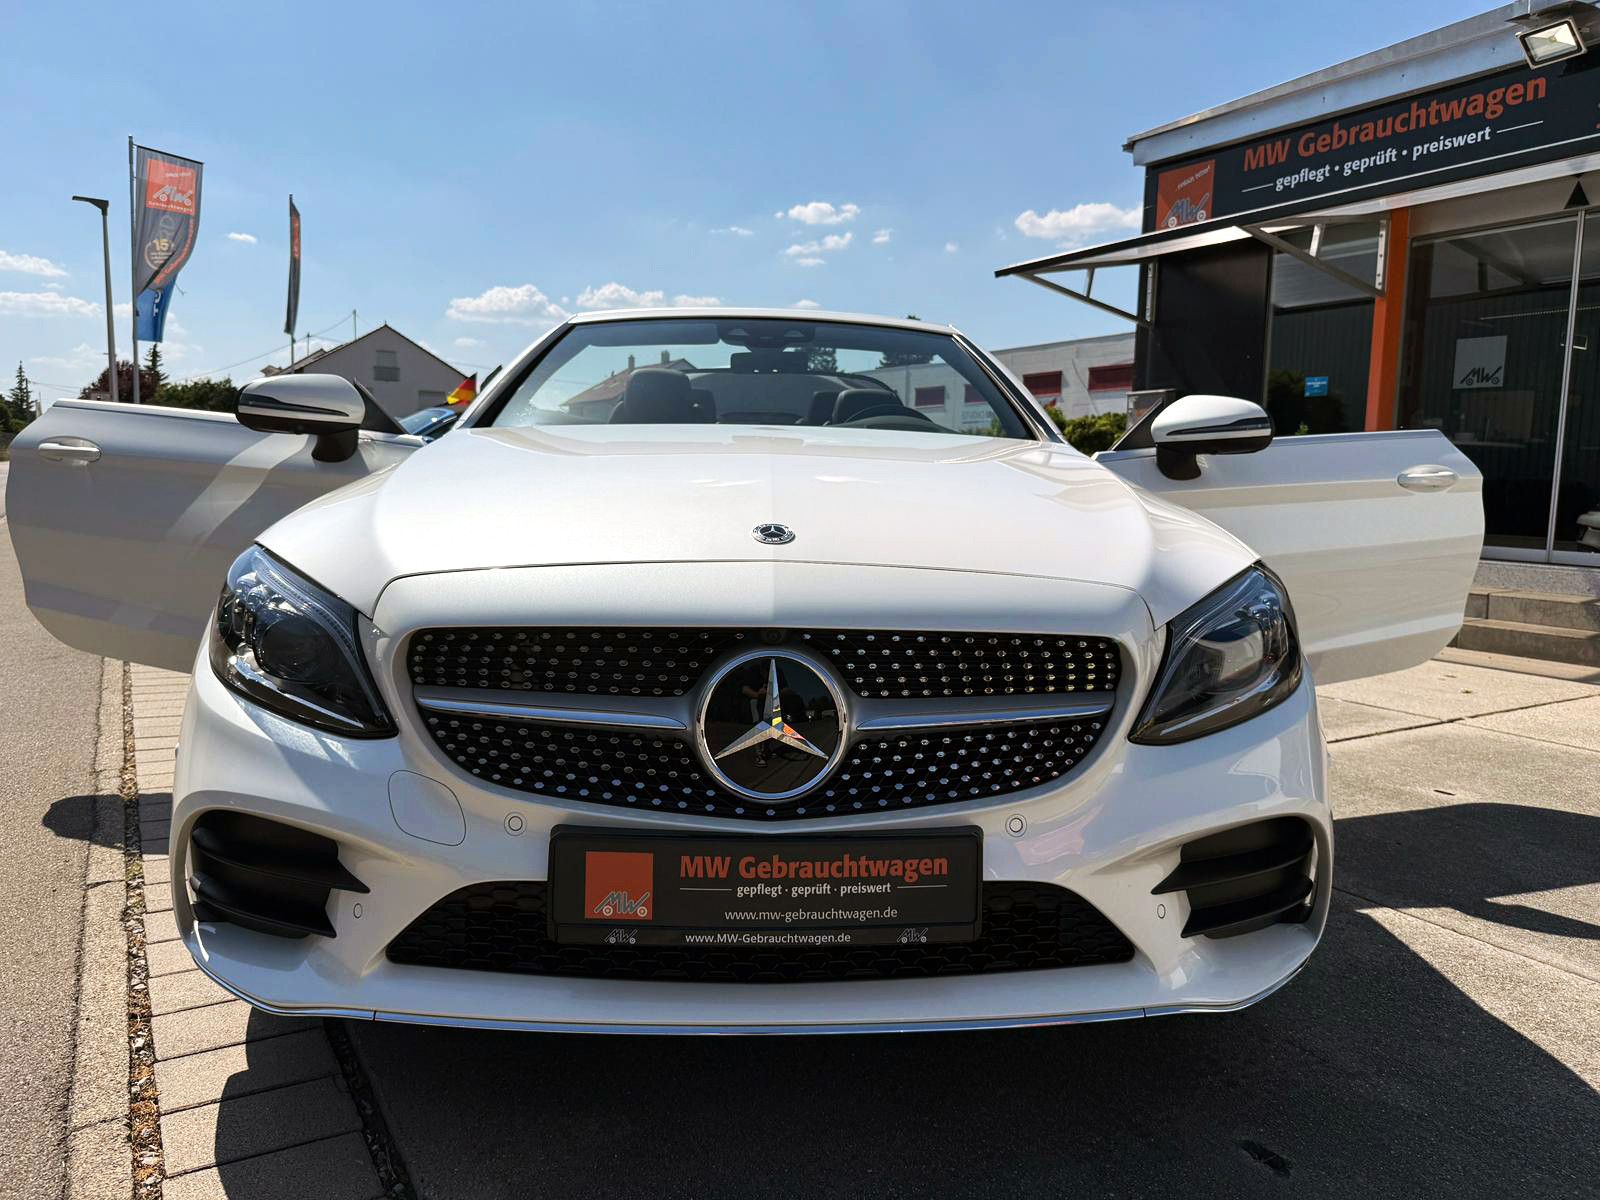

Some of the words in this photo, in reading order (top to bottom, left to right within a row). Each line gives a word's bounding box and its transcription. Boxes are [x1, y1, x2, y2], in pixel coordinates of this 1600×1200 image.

[1243, 138, 1291, 172] MW
[1298, 76, 1547, 158] Gebrauchtwagen
[1275, 164, 1330, 192] gepflegt
[1343, 148, 1398, 177] geprüft
[1412, 126, 1491, 160] preiswert
[680, 856, 730, 879] MW
[738, 854, 949, 883] Gebrauchtwagen
[736, 884, 783, 898] gepflegt
[791, 883, 832, 898] geprüft
[840, 882, 892, 897] preiswert
[724, 906, 899, 923] www.mw-gebrauchtwagen.de
[685, 932, 851, 946] www.MW-Gebrauchtwagen.de
